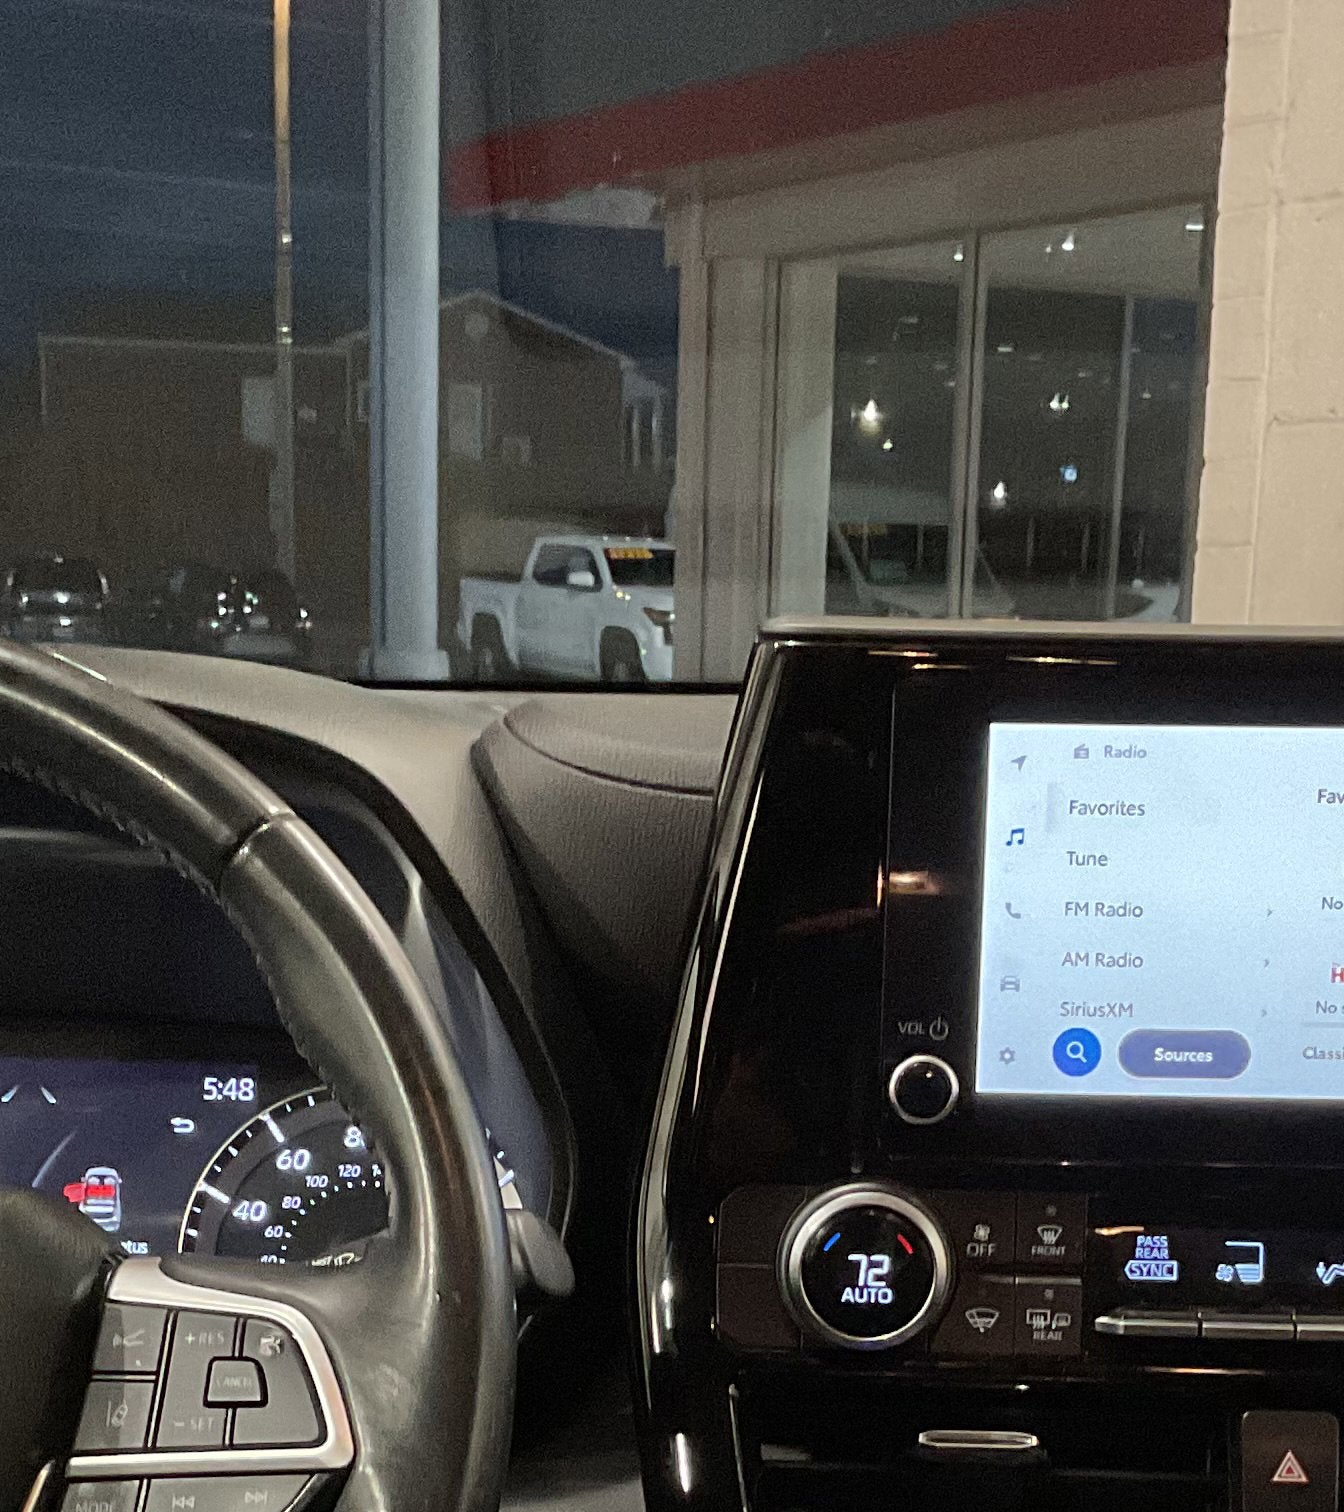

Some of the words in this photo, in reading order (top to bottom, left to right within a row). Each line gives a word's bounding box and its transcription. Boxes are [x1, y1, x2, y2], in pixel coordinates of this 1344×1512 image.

[1103, 743, 1147, 759] Radio
[1069, 799, 1145, 817] Favorites
[1067, 851, 1108, 867] Tune
[1064, 902, 1089, 918] FM
[1095, 901, 1143, 918] Radio
[1322, 897, 1343, 911] No
[1061, 952, 1089, 968] AM
[1095, 952, 1143, 969] Radio
[1060, 1002, 1134, 1018] SiriusXM
[1316, 1001, 1339, 1016] No
[898, 1022, 925, 1035] VOL
[1154, 1047, 1213, 1064] Sources
[203, 1077, 254, 1101] 5:48
[276, 1149, 311, 1171] 60
[338, 1164, 361, 1177] 120
[305, 1175, 329, 1188] 100
[282, 1196, 301, 1209] 80
[233, 1200, 267, 1222] 40
[264, 1225, 283, 1238] 60
[967, 1243, 995, 1257] OFF
[1136, 1236, 1168, 1248] PASS
[1032, 1246, 1066, 1256] FRONT
[1135, 1248, 1169, 1259] REAR
[848, 1254, 891, 1287] 72
[1130, 1263, 1175, 1279] SYNC
[841, 1287, 893, 1304] AUTO
